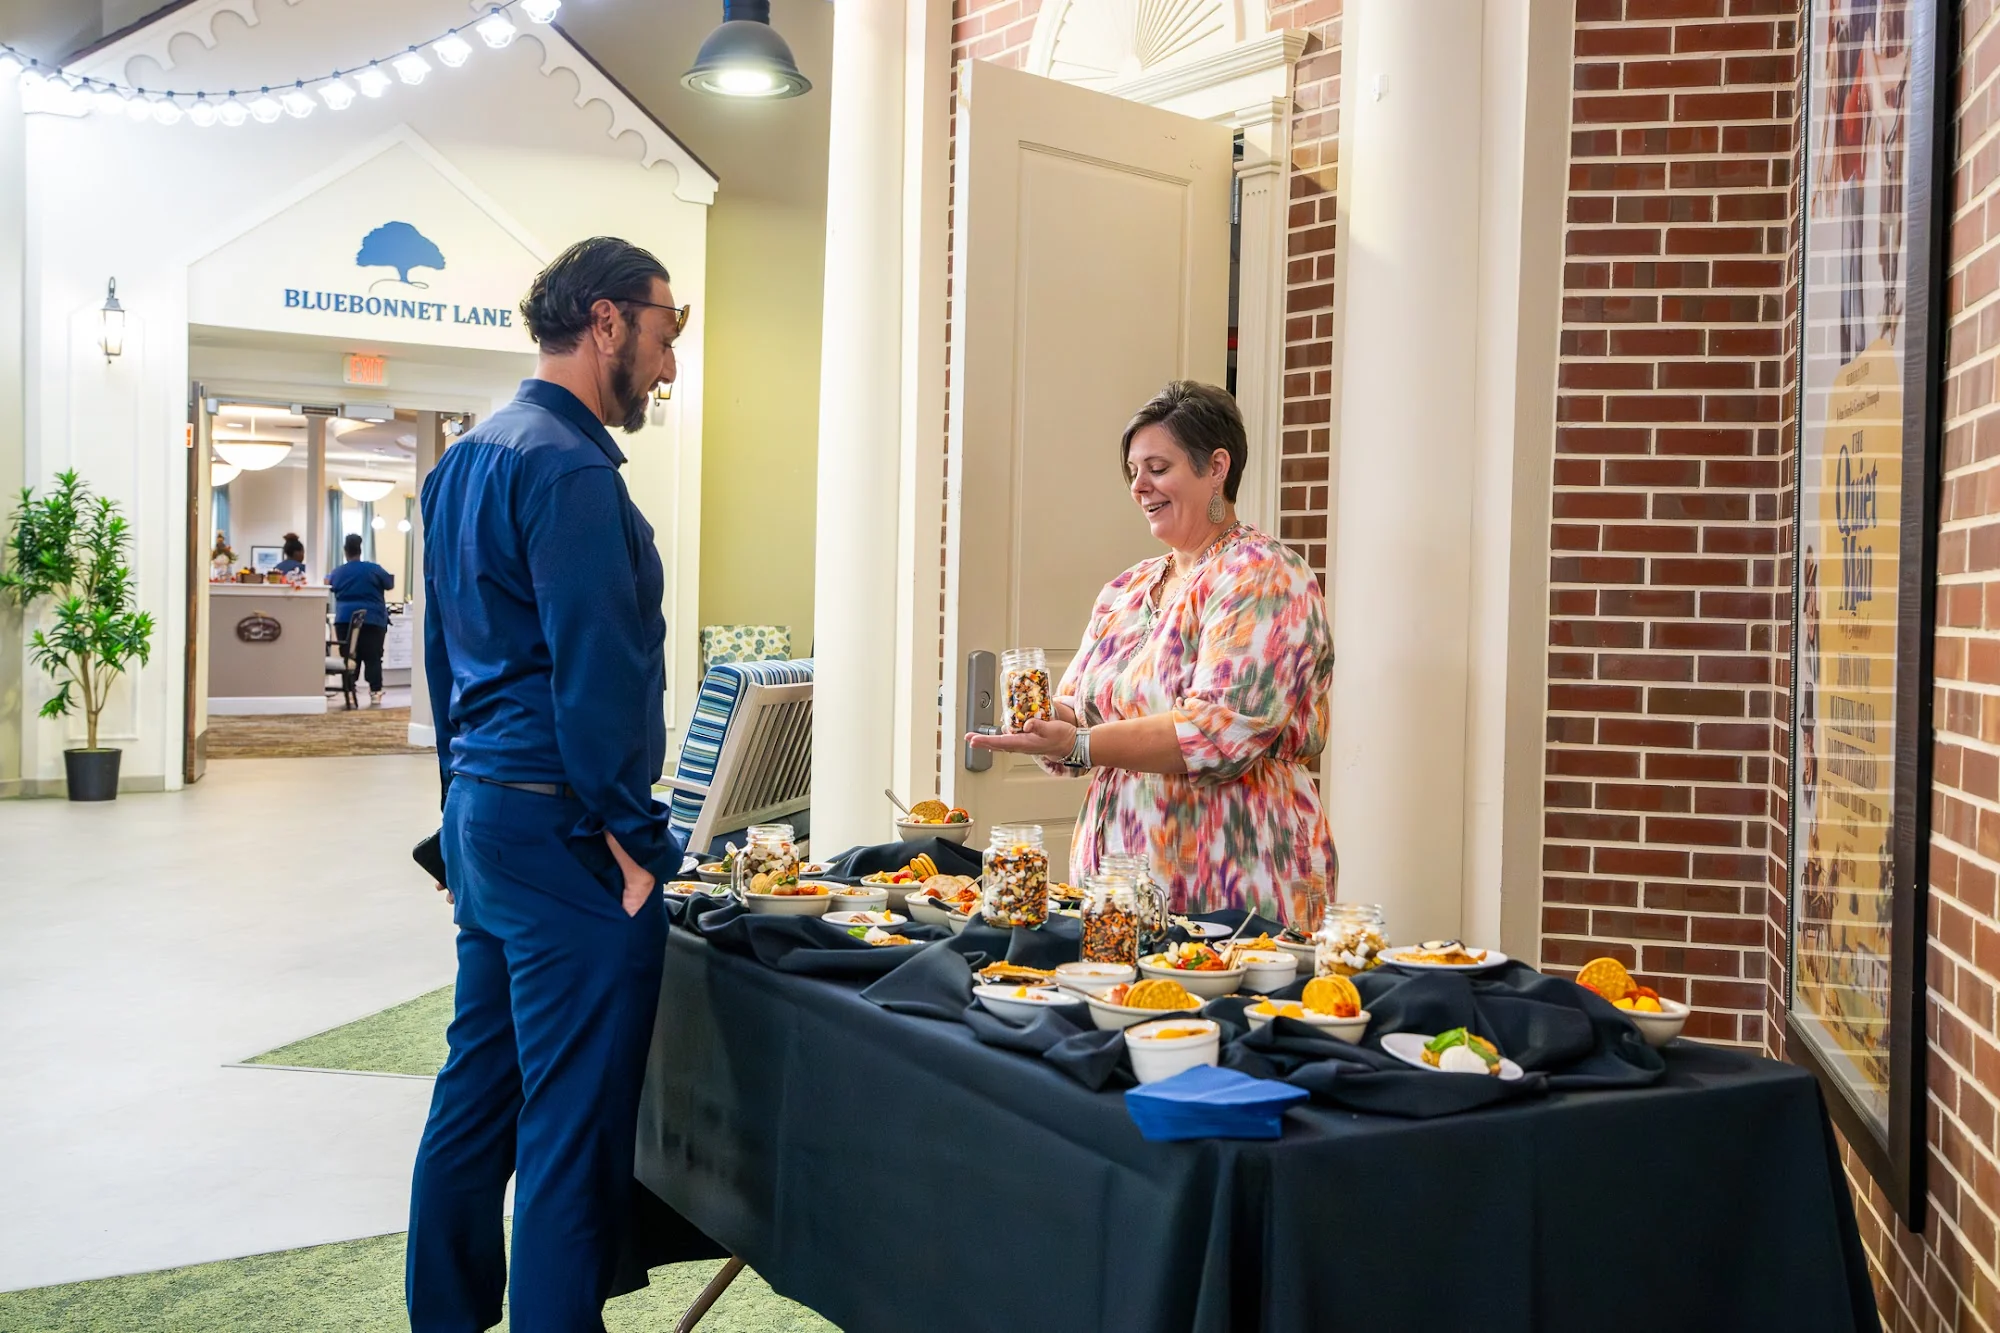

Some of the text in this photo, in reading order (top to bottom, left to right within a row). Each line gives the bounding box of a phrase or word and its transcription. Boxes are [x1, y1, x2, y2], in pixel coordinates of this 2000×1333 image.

[284, 288, 513, 328] BLUEBONNET LANE
[350, 356, 385, 385] EXIT
[1851, 430, 1864, 455] THE
[1835, 444, 1878, 537] Quiet
[1838, 536, 1873, 611] Man
